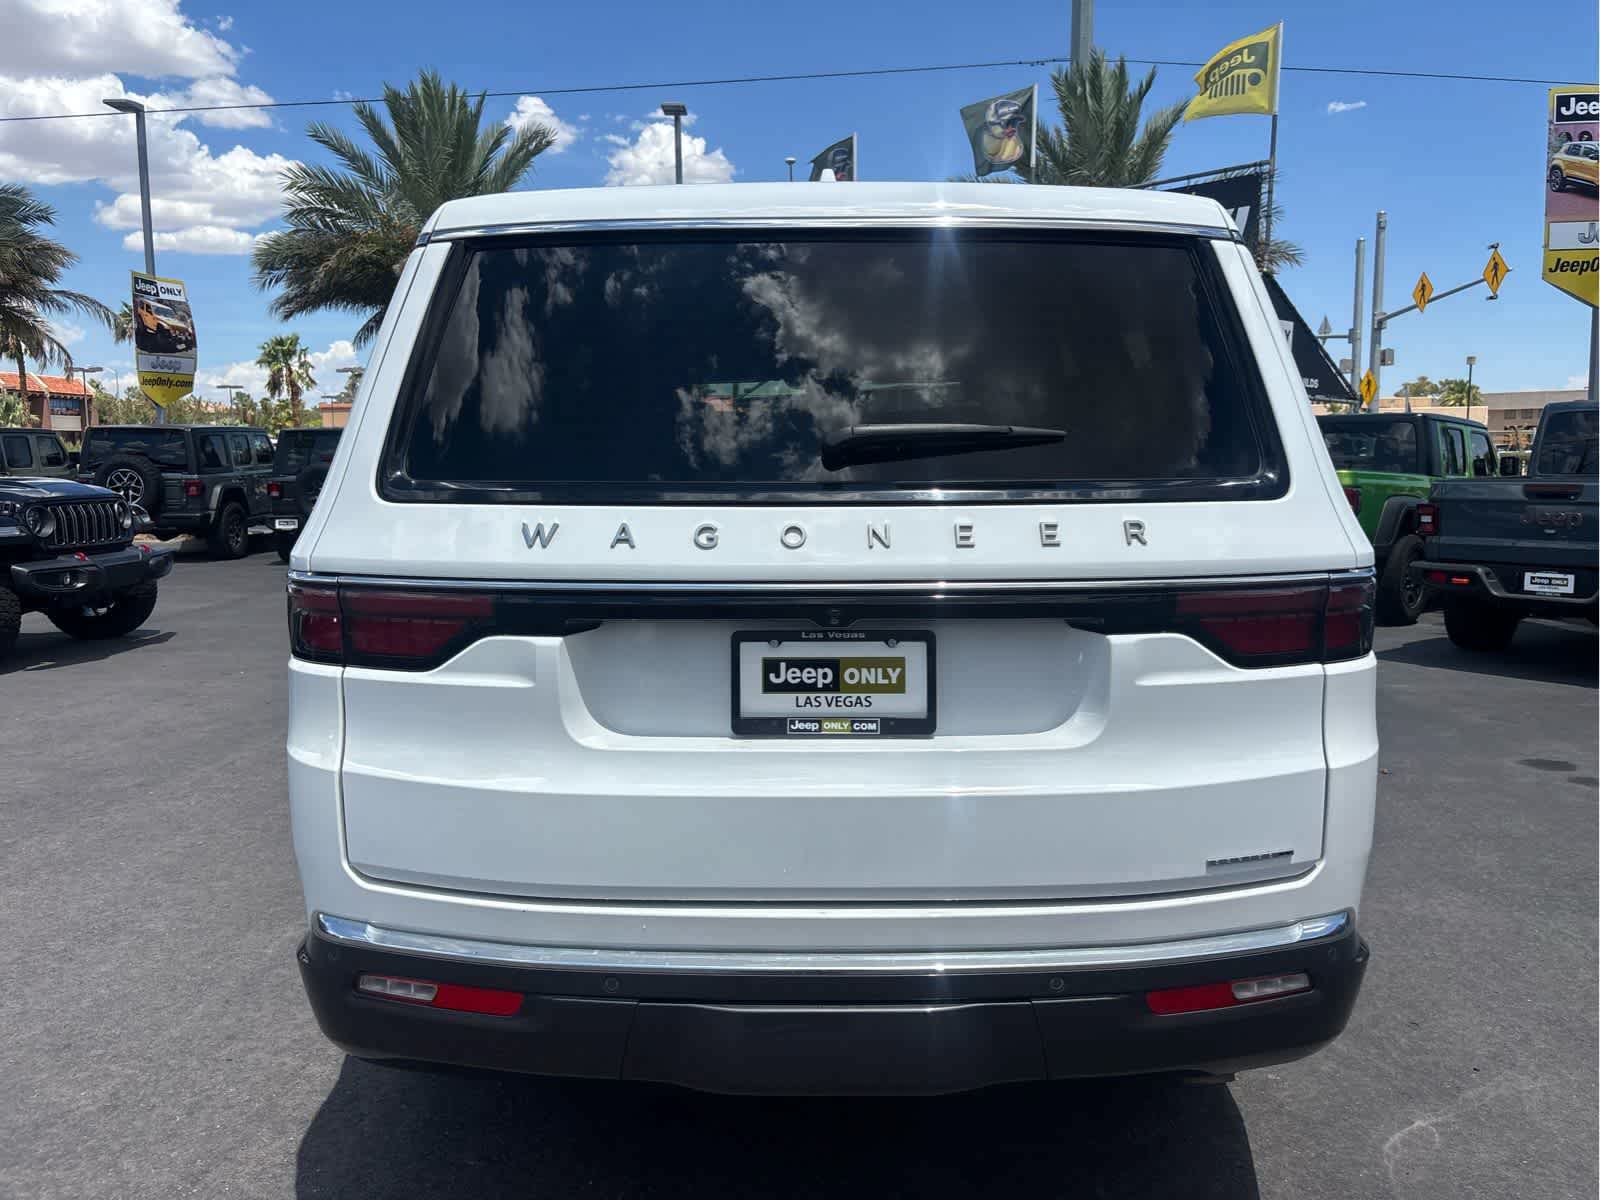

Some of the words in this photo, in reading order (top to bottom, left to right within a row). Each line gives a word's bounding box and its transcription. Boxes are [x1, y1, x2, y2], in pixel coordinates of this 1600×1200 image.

[1577, 222, 1599, 245] J
[135, 280, 157, 296] Jeep
[160, 286, 182, 297] ONLY
[150, 356, 182, 373] Jeep
[141, 376, 193, 390] JeepOnly.com
[521, 519, 1148, 550] WAGONEER
[801, 631, 823, 639] Las
[827, 631, 866, 640] Vegas
[769, 662, 834, 688] Jeep
[843, 667, 903, 685] ONLY
[795, 695, 822, 708] LAS
[826, 695, 873, 709] VEGAS
[790, 719, 820, 732] Jeep
[823, 721, 850, 731] ONLY
[853, 721, 877, 731] COM
